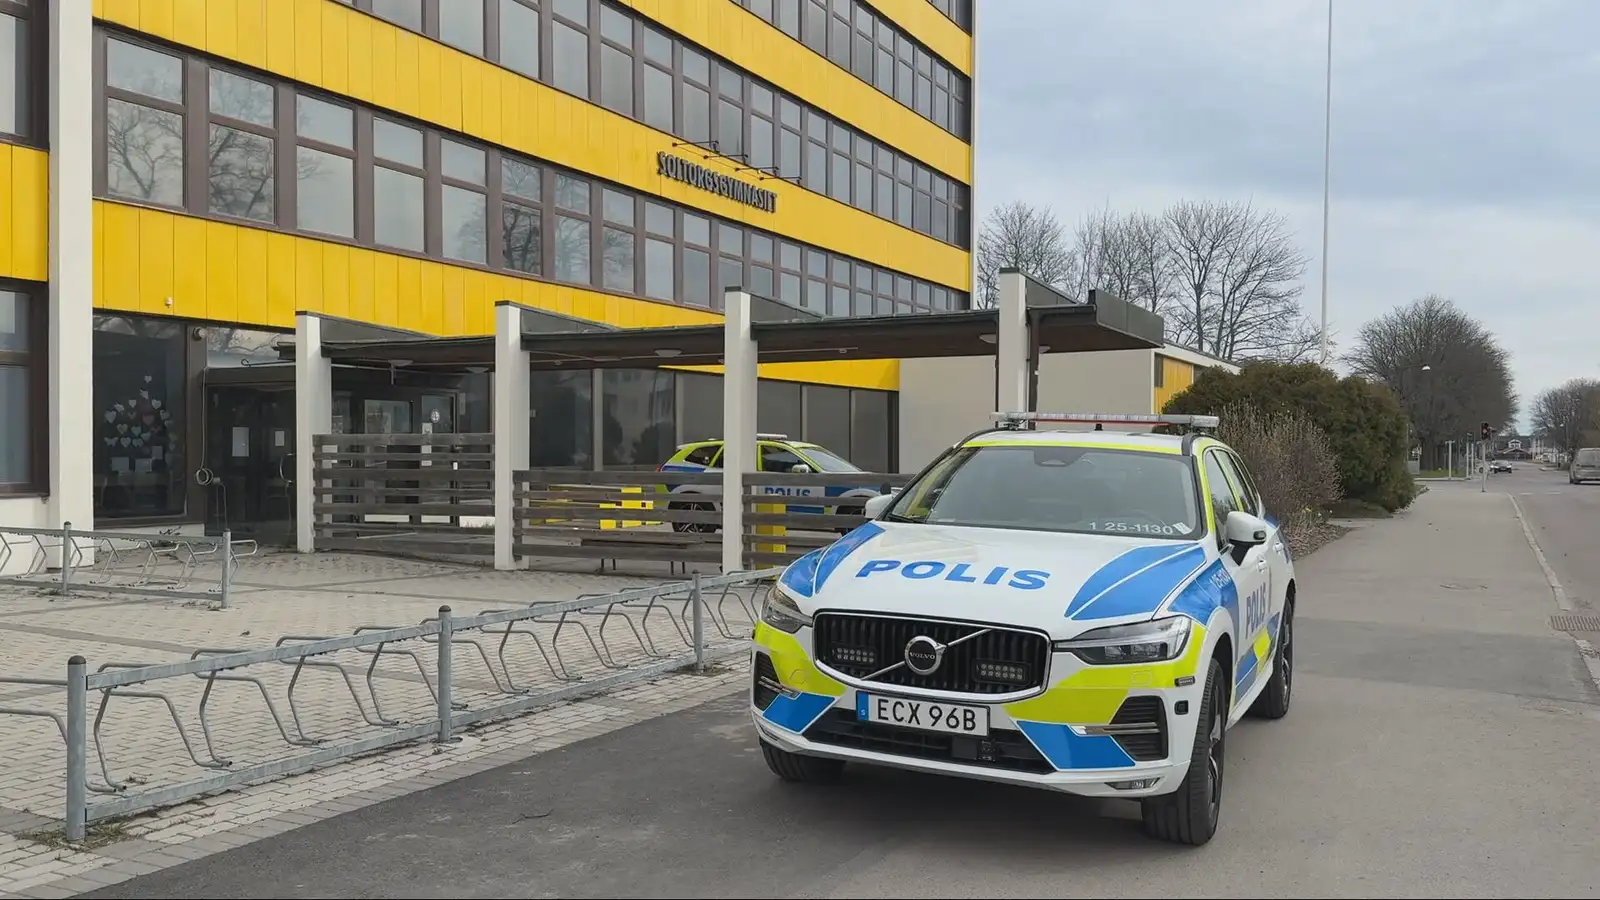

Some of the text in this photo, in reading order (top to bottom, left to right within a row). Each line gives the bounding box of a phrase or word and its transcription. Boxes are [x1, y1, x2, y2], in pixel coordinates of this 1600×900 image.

[1089, 522, 1174, 535] 1 25-1130
[855, 560, 1051, 590] POLIS
[1245, 581, 1267, 640] POLIS
[909, 652, 936, 660] VOLVO
[860, 708, 866, 716] S
[877, 699, 976, 731] ECX 96B
